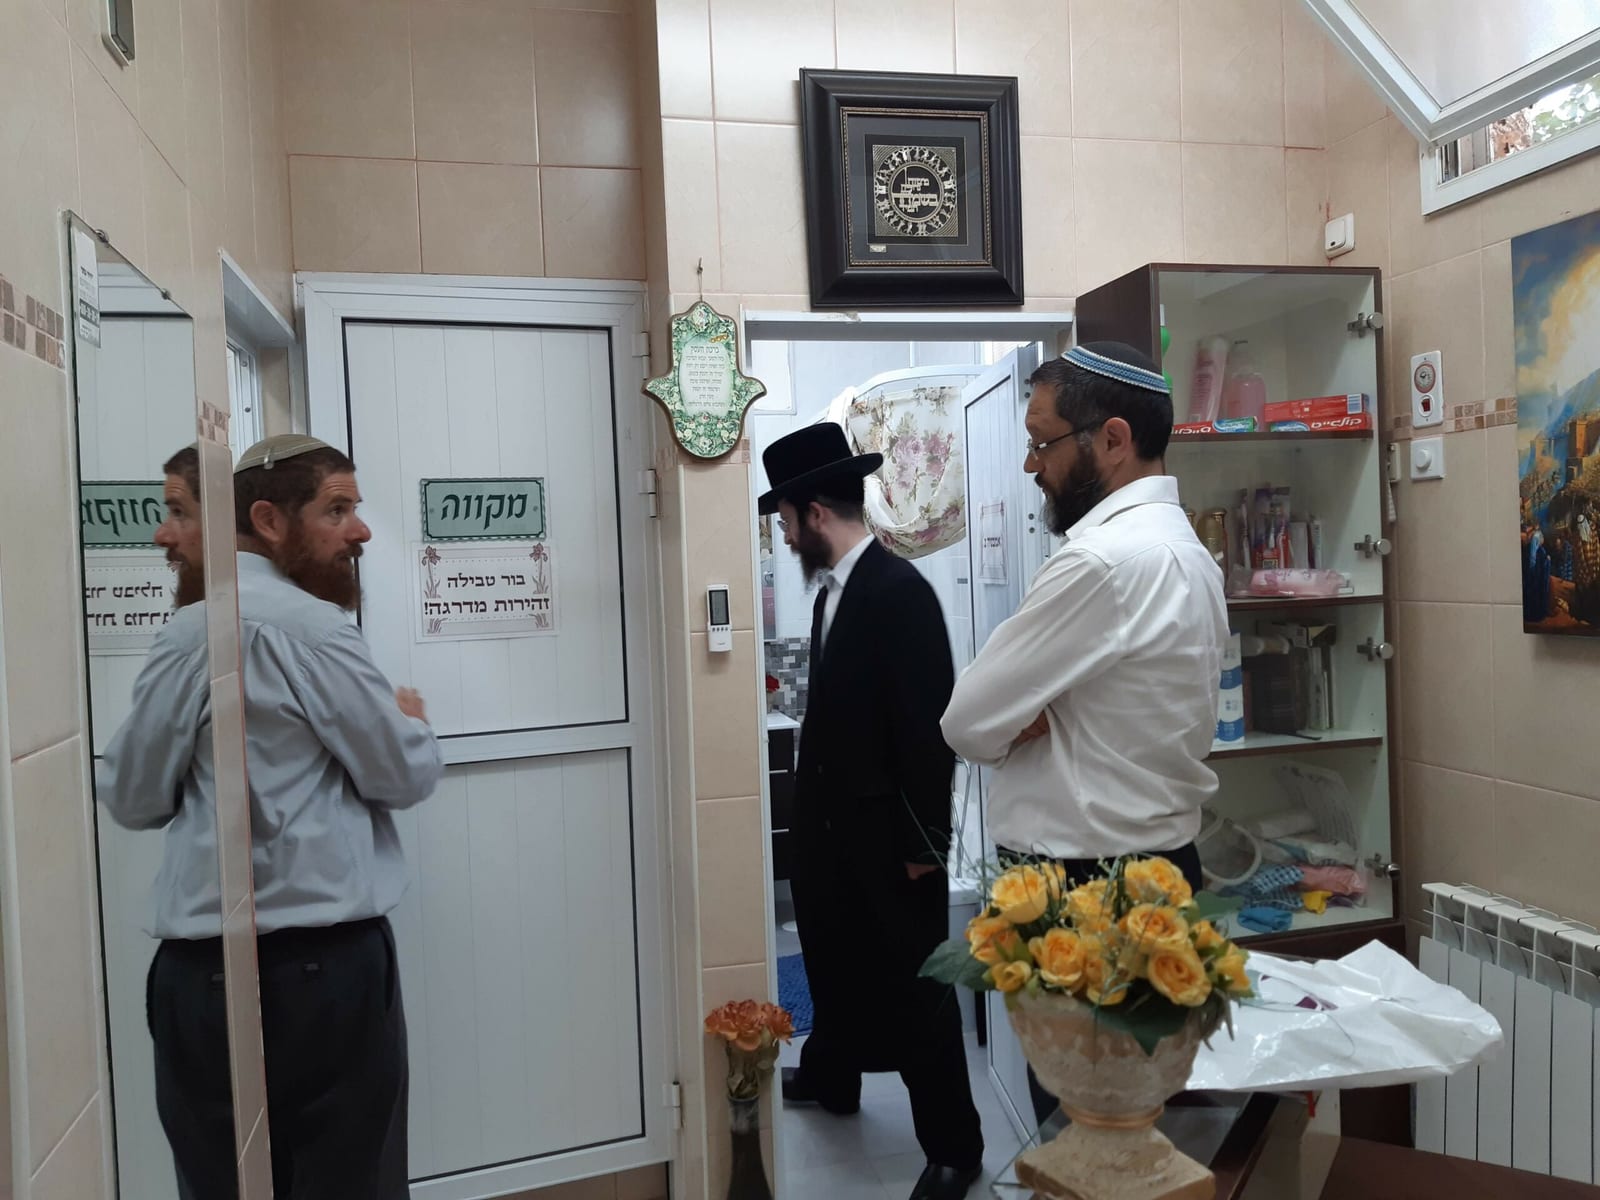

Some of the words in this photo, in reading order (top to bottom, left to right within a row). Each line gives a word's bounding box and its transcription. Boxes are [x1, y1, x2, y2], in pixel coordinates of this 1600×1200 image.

[440, 493, 528, 530] מקווה
[447, 572, 496, 588] טבילה
[501, 574, 526, 586] בור
[424, 600, 487, 615] מדרגה!
[494, 598, 550, 612] זהירות
